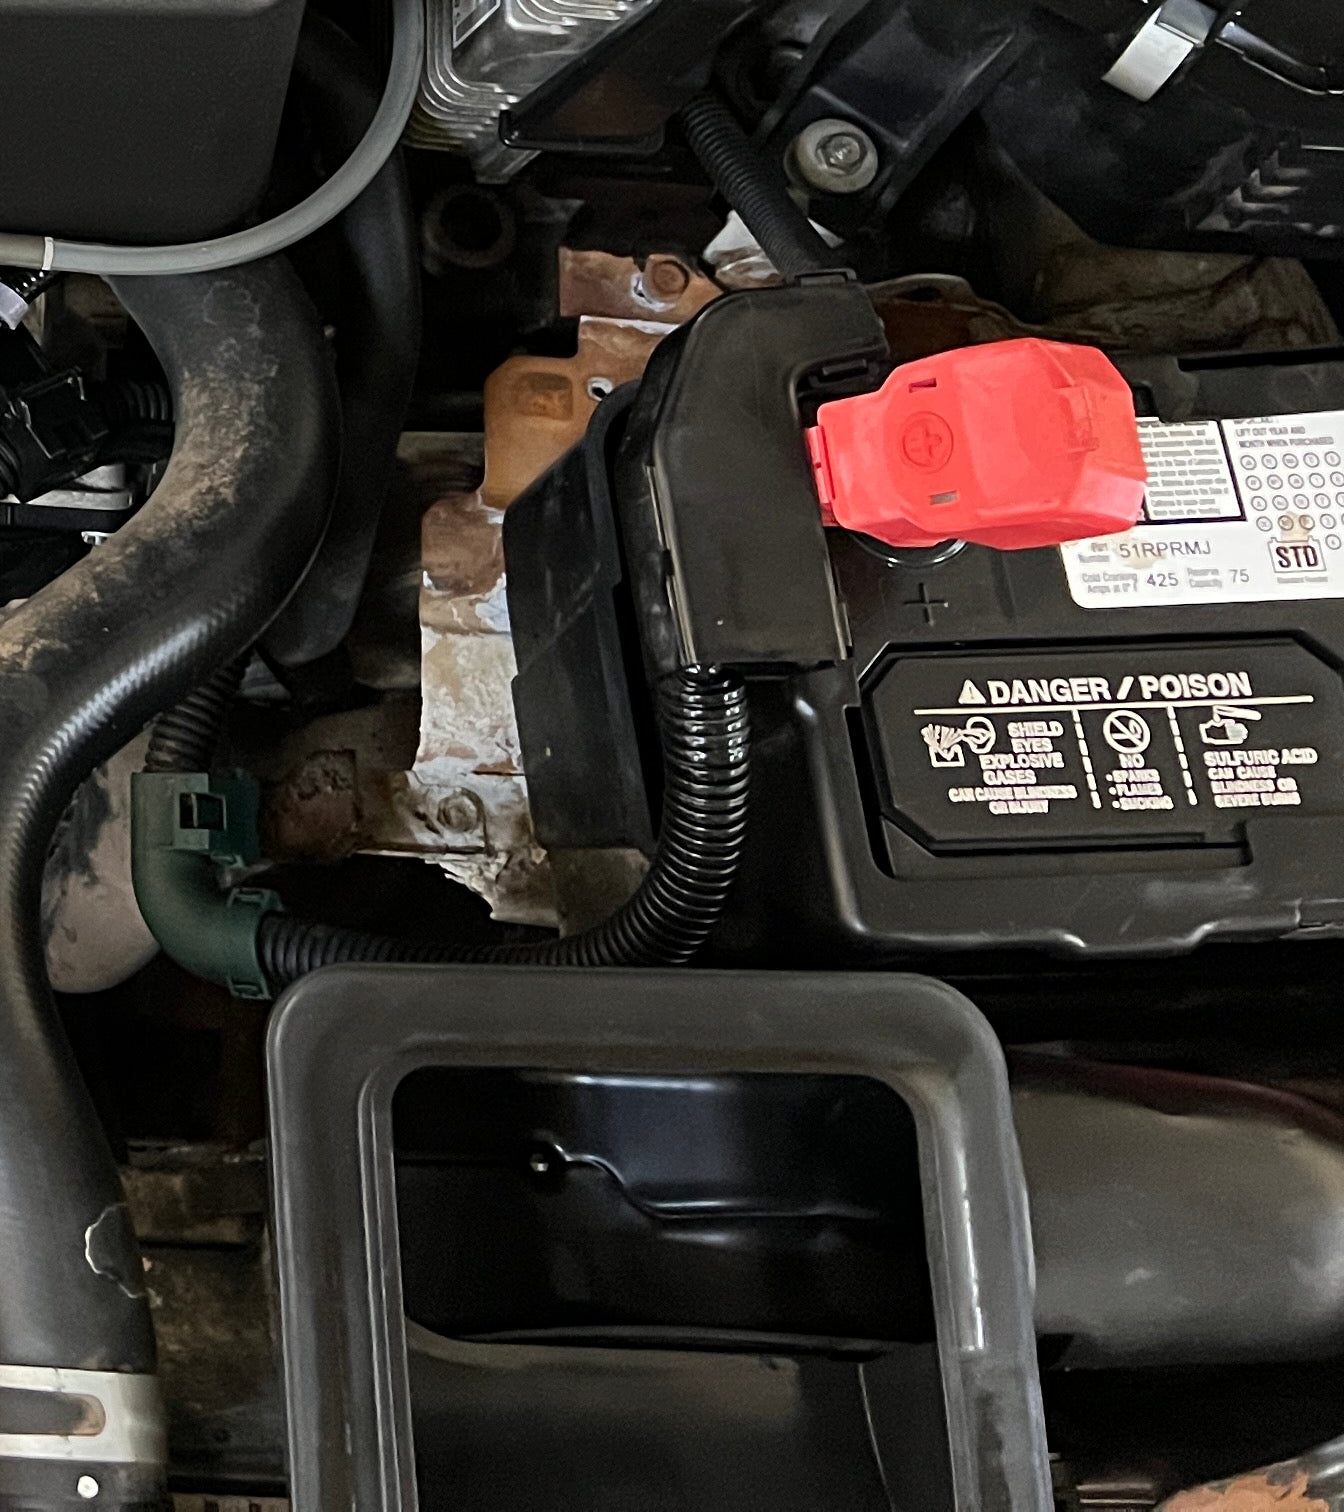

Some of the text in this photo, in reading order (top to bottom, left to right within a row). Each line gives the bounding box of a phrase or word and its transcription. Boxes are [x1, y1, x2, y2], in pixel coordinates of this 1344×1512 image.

[1119, 541, 1211, 558] 51RPRMJ
[1275, 545, 1319, 569] STD
[1146, 572, 1179, 587] 425
[1229, 569, 1250, 583] 75
[987, 672, 1253, 705] DANGER / POISON
[1007, 720, 1064, 737] SHIELD
[1011, 737, 1053, 754] EYES
[979, 752, 1064, 770] EXPLOSIVE
[1118, 753, 1146, 769] NO
[1202, 747, 1318, 767] SULFURIC ACID
[983, 769, 1036, 786] GASES
